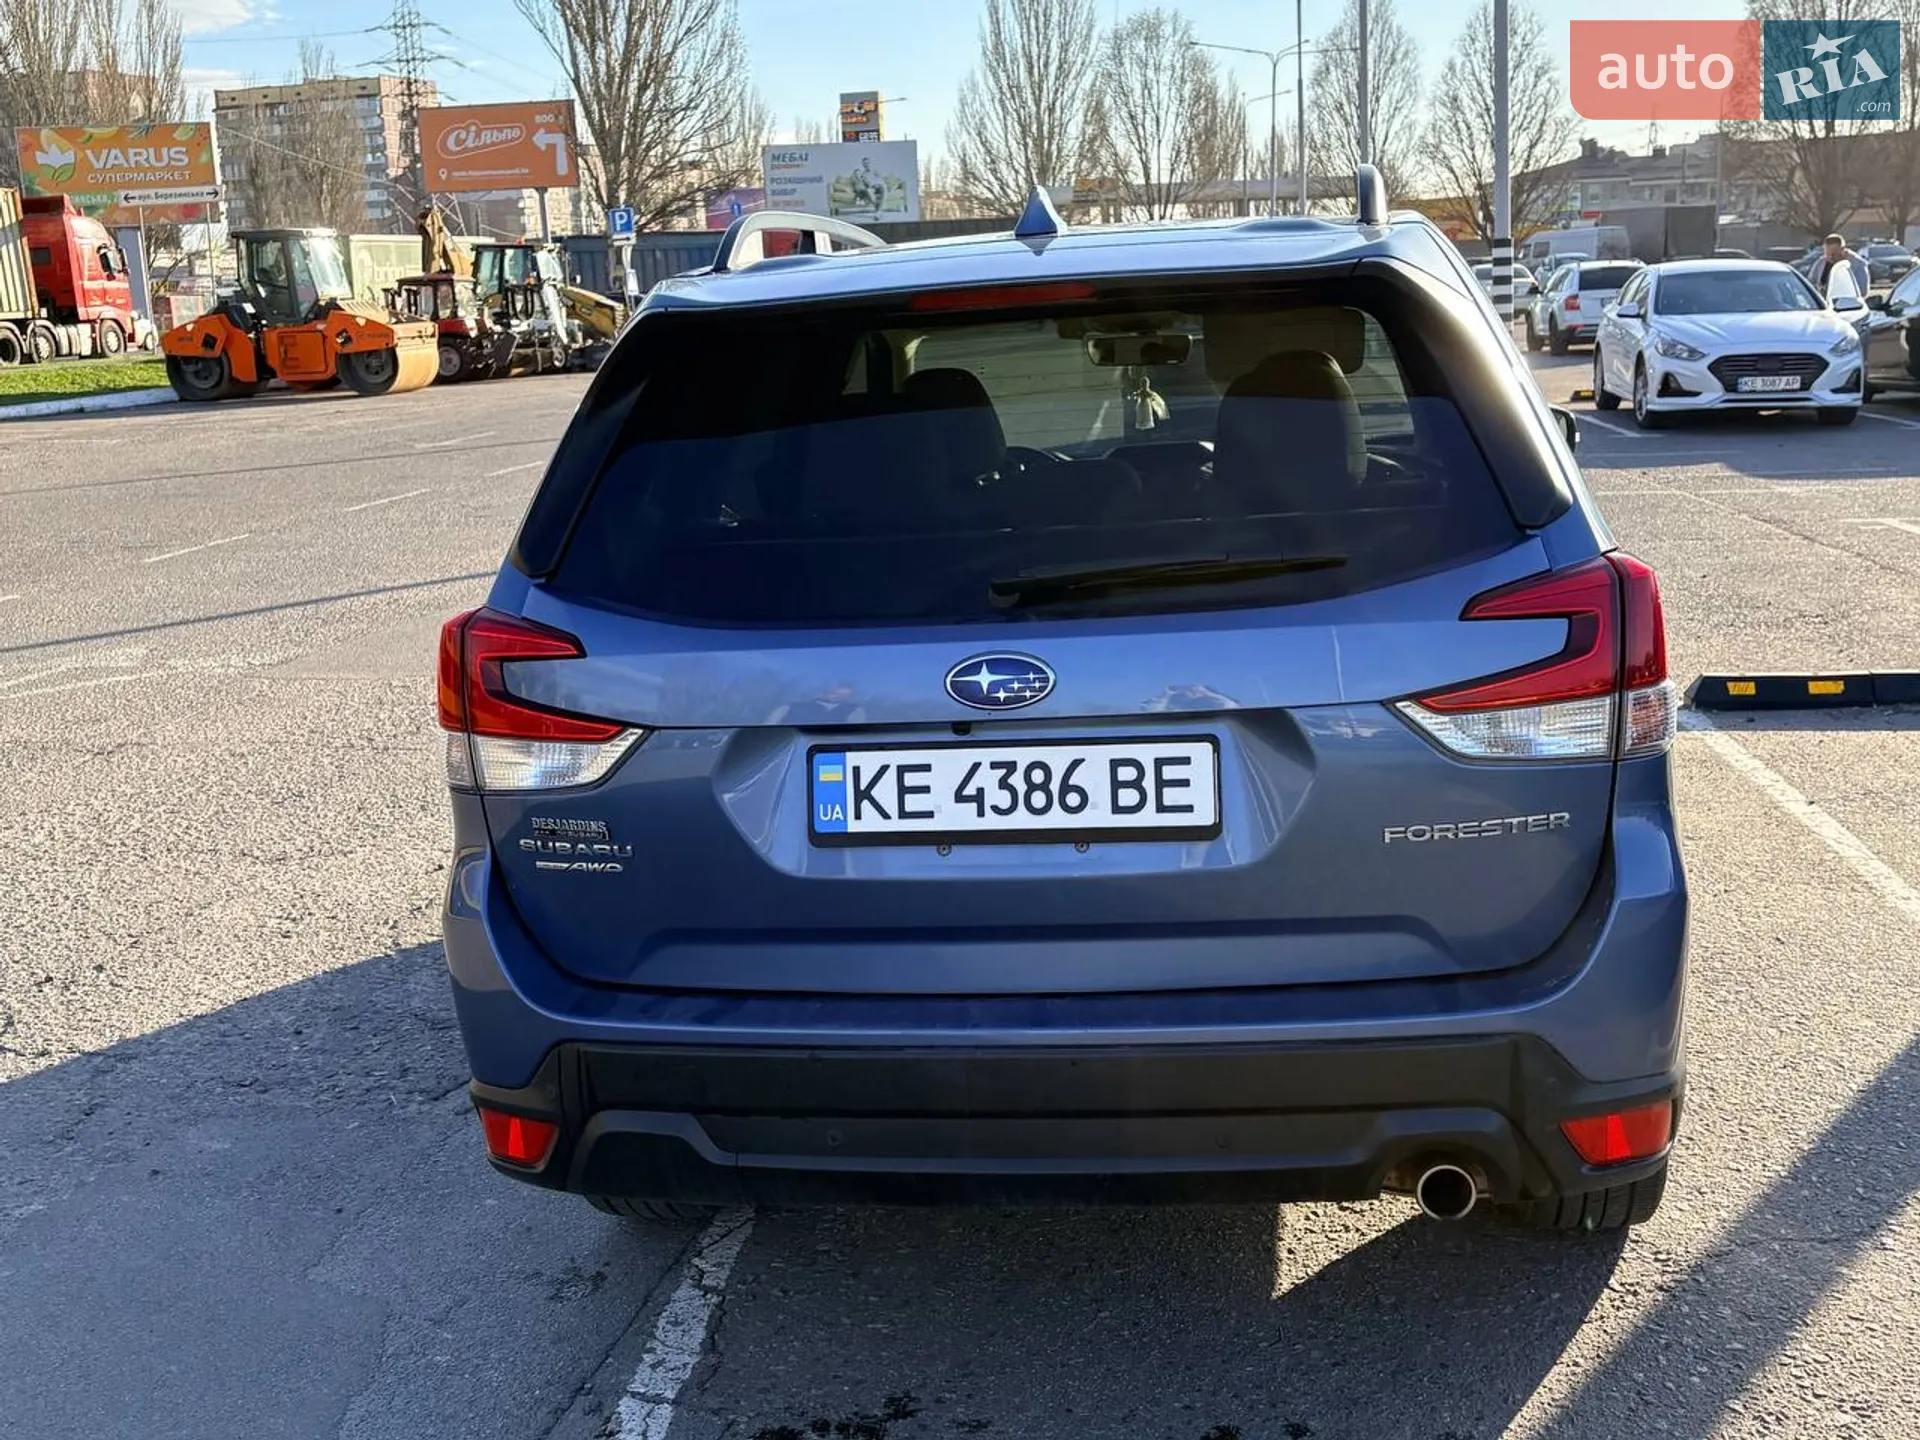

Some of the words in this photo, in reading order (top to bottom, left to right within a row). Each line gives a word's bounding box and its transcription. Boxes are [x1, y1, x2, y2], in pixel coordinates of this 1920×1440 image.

[446, 125, 521, 152] Сільпо
[85, 146, 190, 169] VARUS
[88, 170, 192, 183] СУПЕРМАРКЕТ
[615, 211, 628, 231] P
[852, 763, 935, 821] KE
[954, 758, 1089, 818] 4386
[1109, 756, 1194, 815] BE
[819, 804, 845, 822] UA
[531, 817, 608, 833] DESJARDINS
[1384, 812, 1571, 844] FORESTER
[519, 839, 634, 857] SUBARU
[567, 861, 623, 873] AWD
